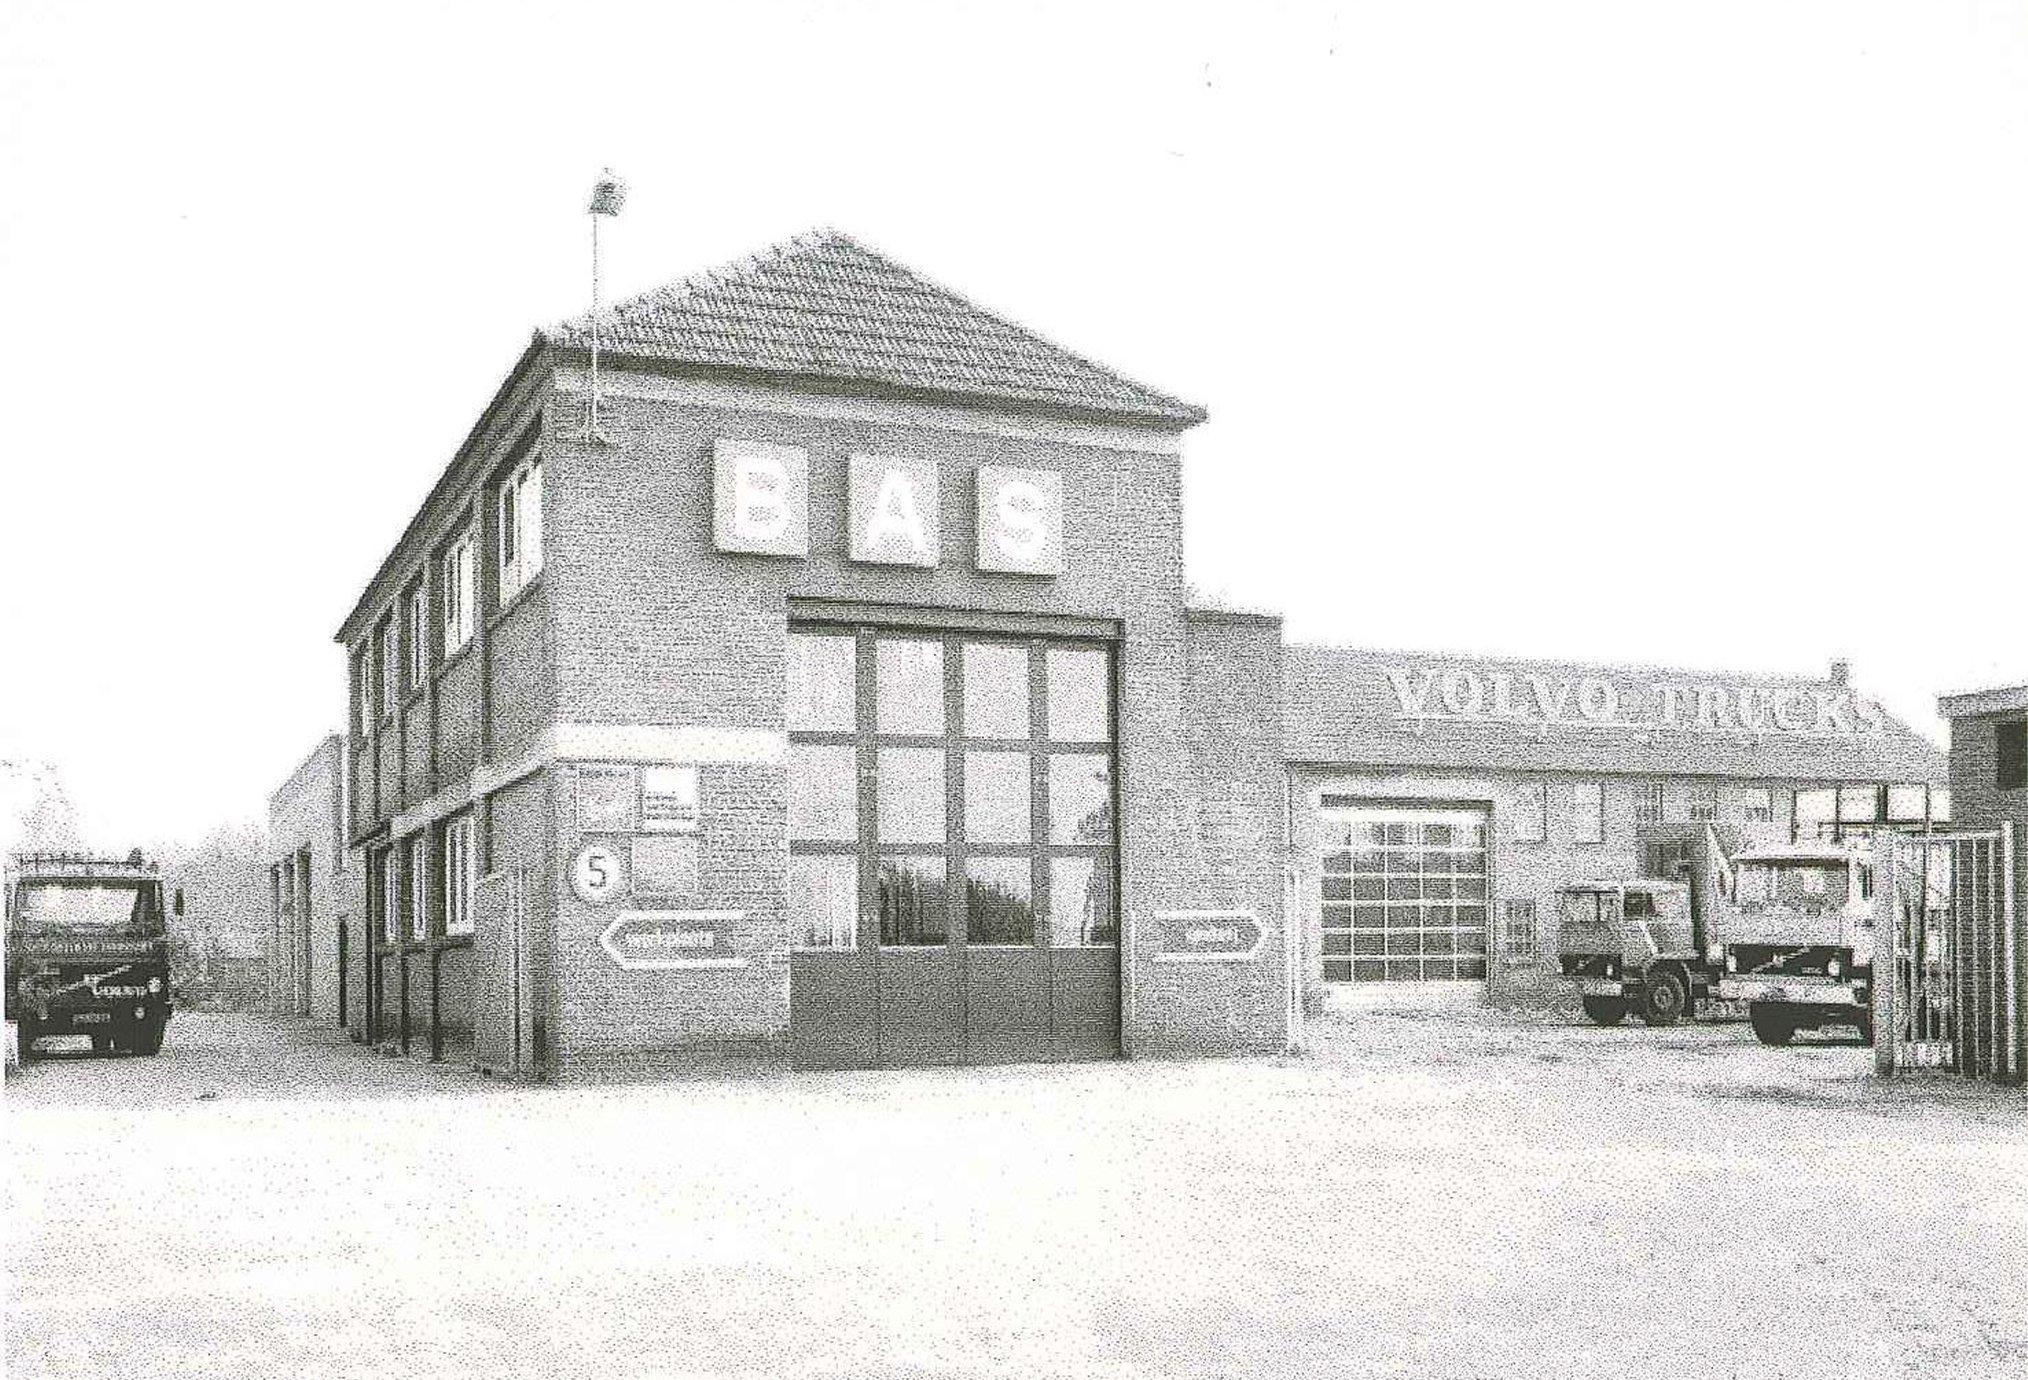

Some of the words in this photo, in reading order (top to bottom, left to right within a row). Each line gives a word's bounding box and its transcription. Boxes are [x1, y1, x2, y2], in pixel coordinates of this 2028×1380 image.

[735, 455, 1048, 559] BAS
[1383, 665, 1619, 721] VOLVO
[1653, 683, 1887, 735] TRUCKS
[588, 855, 607, 889] 5
